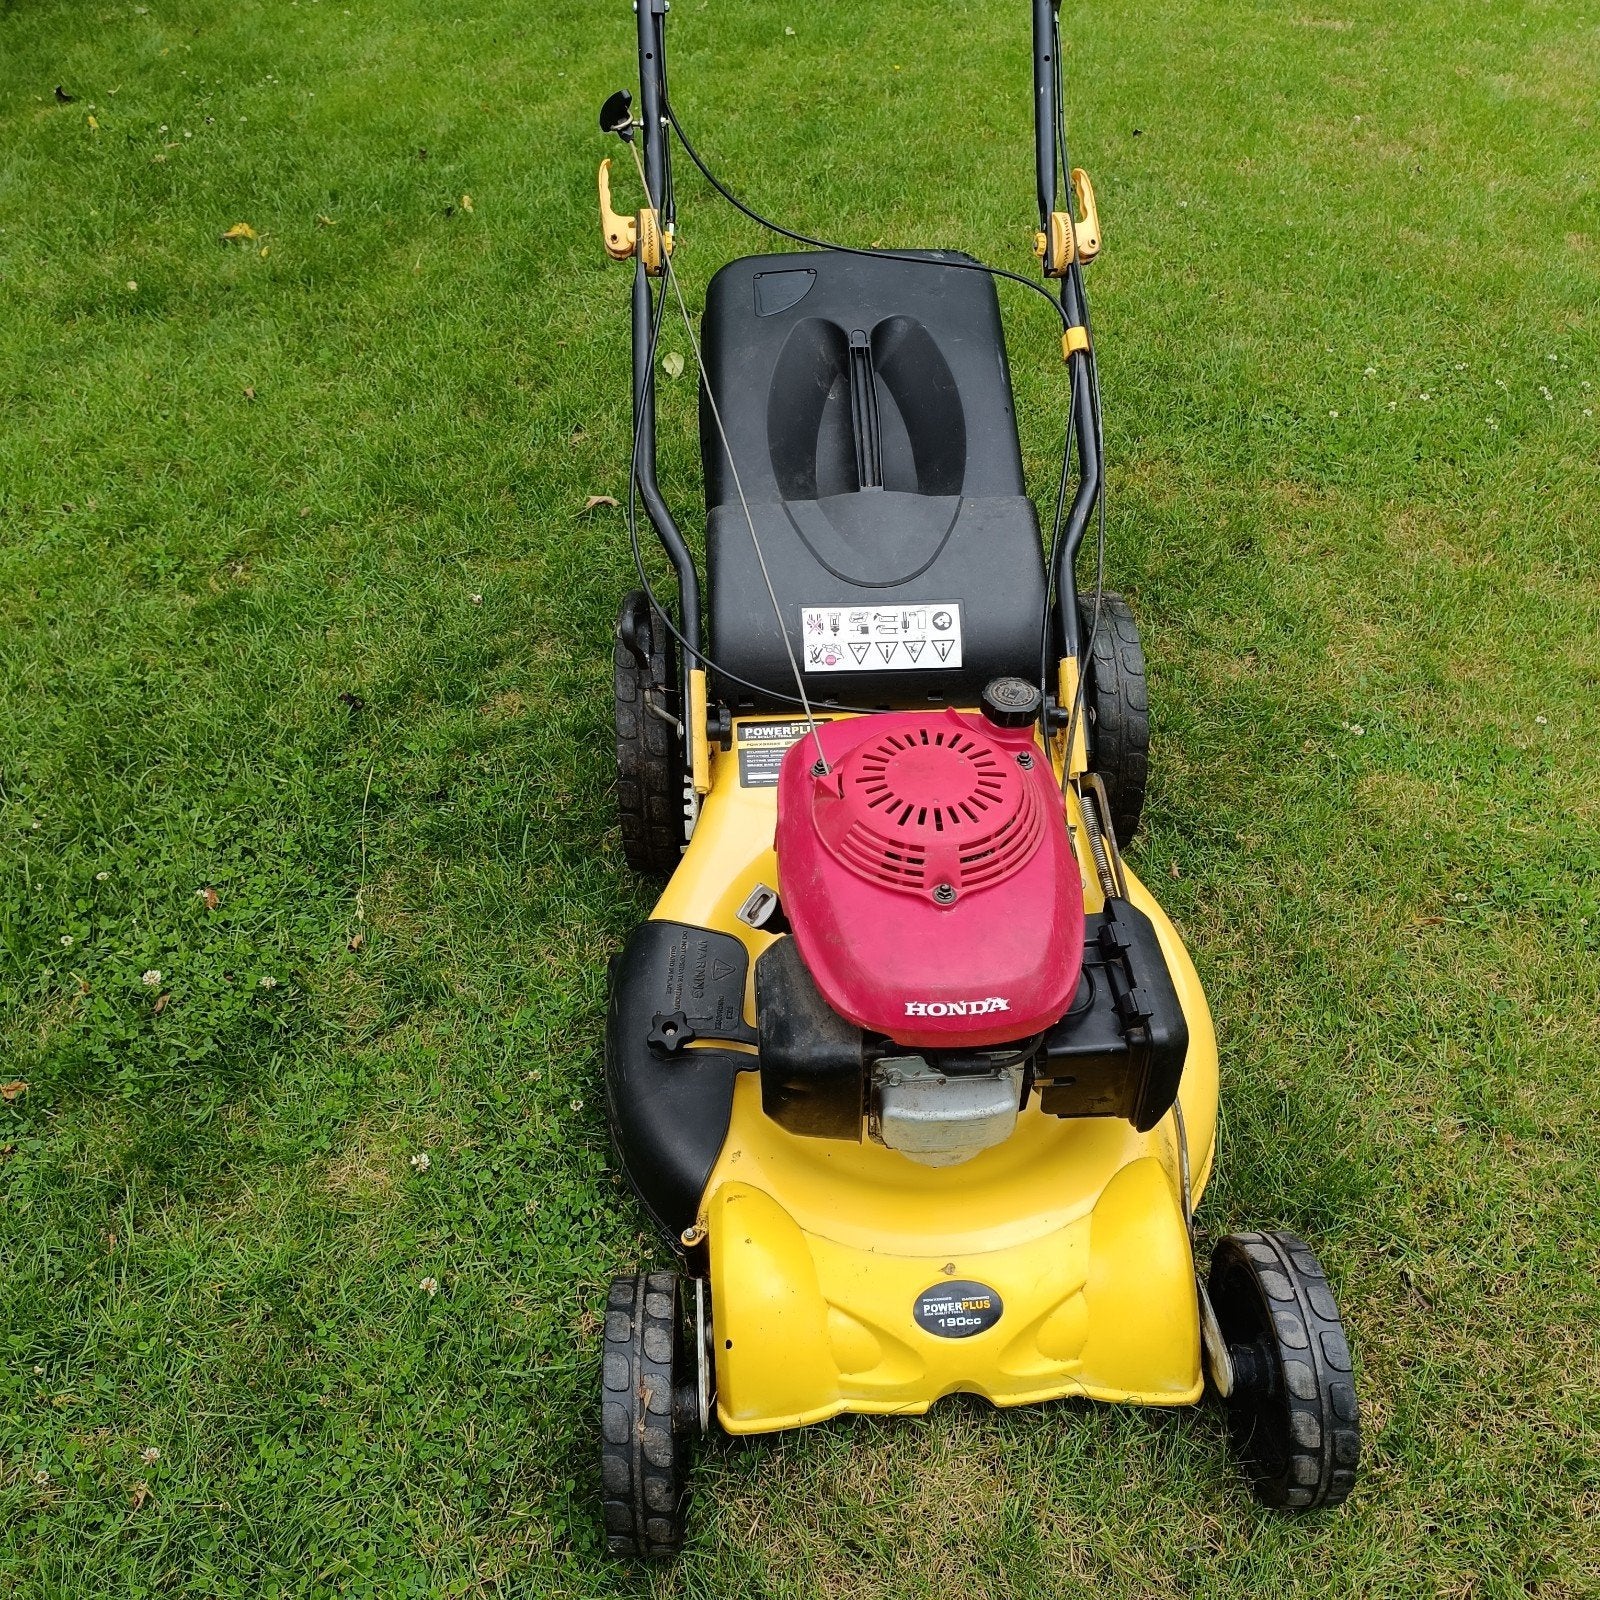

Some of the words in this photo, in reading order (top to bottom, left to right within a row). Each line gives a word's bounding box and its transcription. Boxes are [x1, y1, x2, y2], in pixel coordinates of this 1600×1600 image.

[745, 726, 811, 738] POWERPL
[691, 940, 708, 999] WARNING
[904, 997, 1011, 1017] HONDA
[923, 1300, 991, 1314] POWERPLUS
[938, 1317, 982, 1328] 190cc
